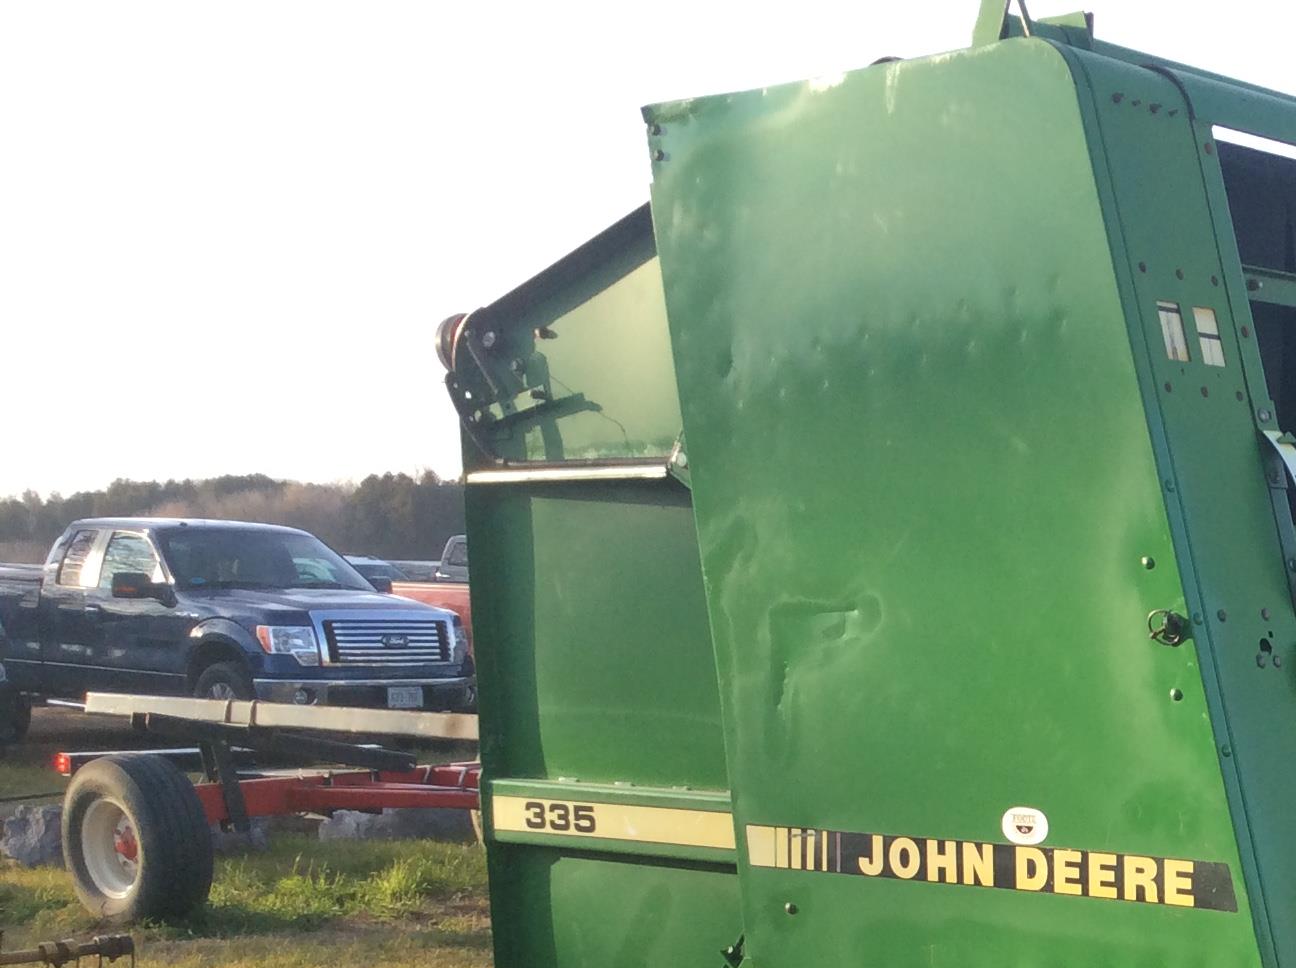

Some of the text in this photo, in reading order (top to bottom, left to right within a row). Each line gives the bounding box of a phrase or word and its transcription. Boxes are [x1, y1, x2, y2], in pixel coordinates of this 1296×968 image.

[525, 801, 596, 833] 335
[858, 834, 1195, 907] JOHN DEERE
